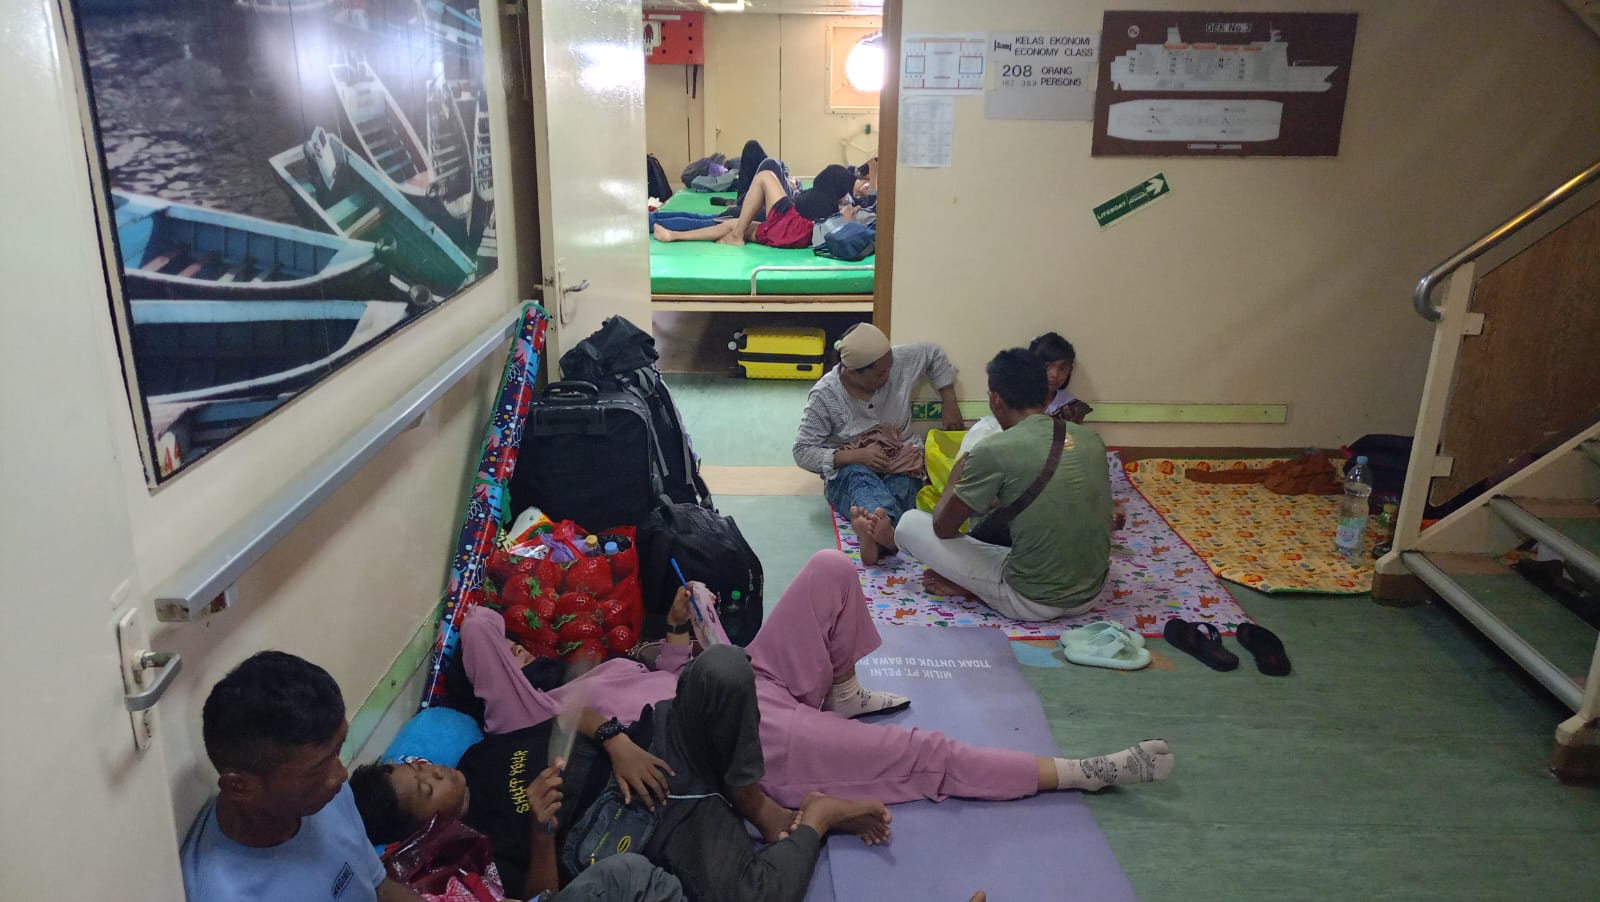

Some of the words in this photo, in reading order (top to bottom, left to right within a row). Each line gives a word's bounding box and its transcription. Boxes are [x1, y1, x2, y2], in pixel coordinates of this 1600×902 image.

[1015, 36, 1044, 45] KELAS
[1049, 36, 1090, 45] EKONOMI
[1014, 48, 1059, 56] ECONOMY
[1064, 48, 1093, 56] CLASS
[1002, 64, 1032, 77] 208
[1041, 66, 1072, 75] ORANG
[1040, 77, 1082, 86] PERSONS
[1097, 201, 1126, 220] LIFEBOAT
[871, 656, 903, 665] BAWA
[905, 657, 916, 666] DI
[919, 658, 956, 667] UNTUK
[958, 659, 992, 668] TIDAK
[870, 668, 901, 677] PELNI
[924, 669, 952, 679] MILIK
[508, 750, 529, 777] YOUR
[508, 778, 531, 814] SHUT
